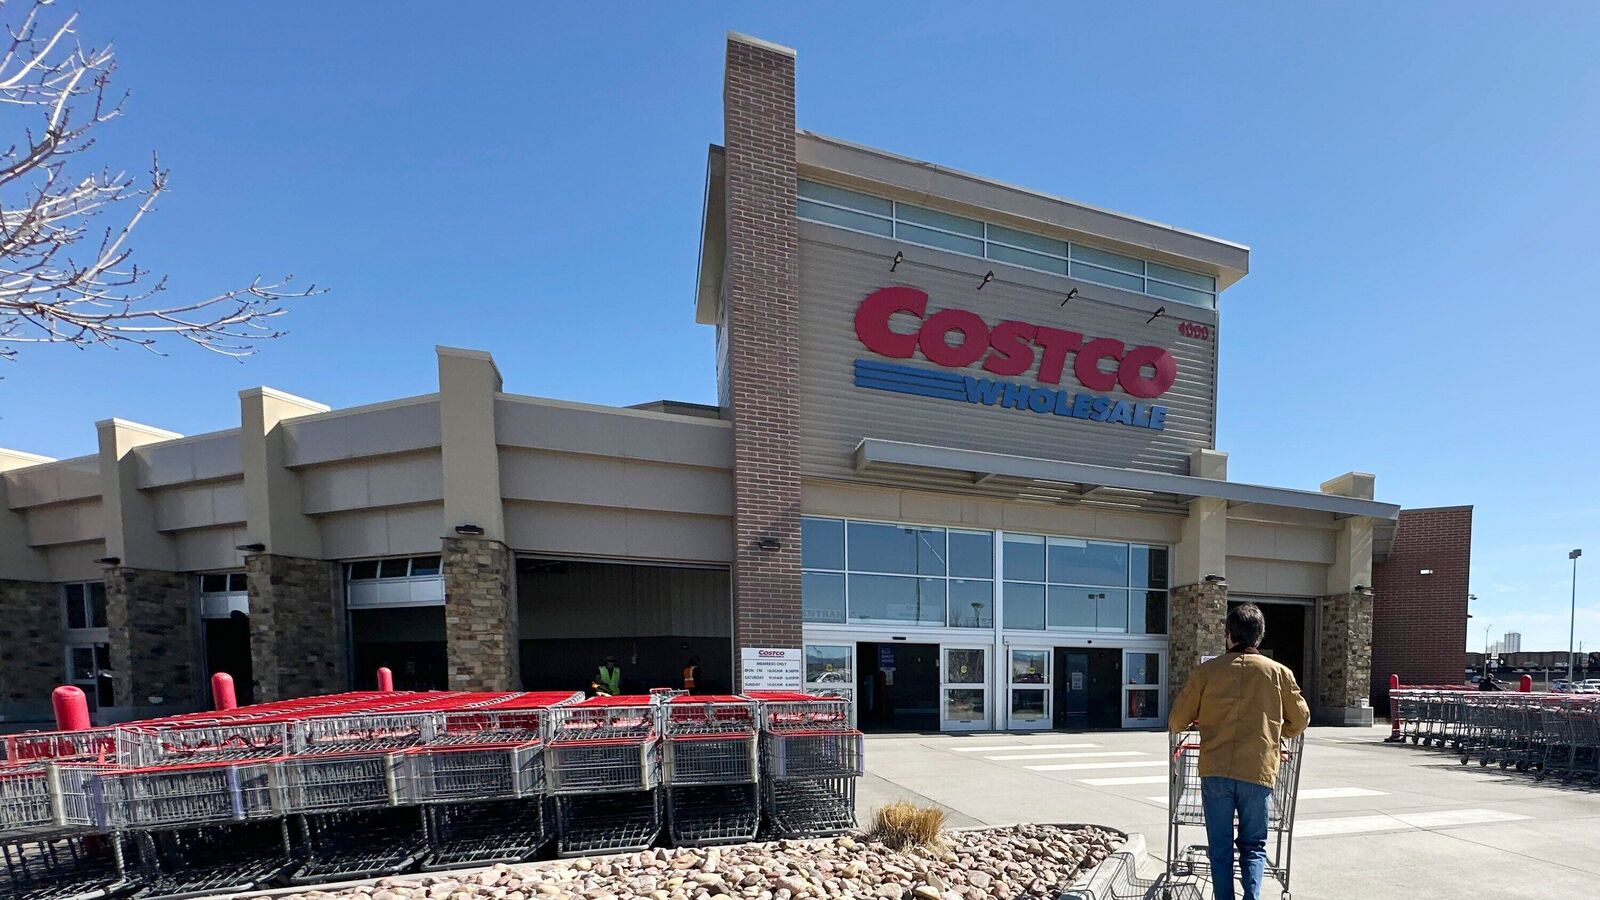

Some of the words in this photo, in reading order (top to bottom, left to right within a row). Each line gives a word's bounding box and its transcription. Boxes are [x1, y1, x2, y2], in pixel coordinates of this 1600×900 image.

[854, 285, 1177, 398] COSTCO
[1178, 321, 1208, 340] 4000
[963, 375, 1168, 430] WHOLESALE
